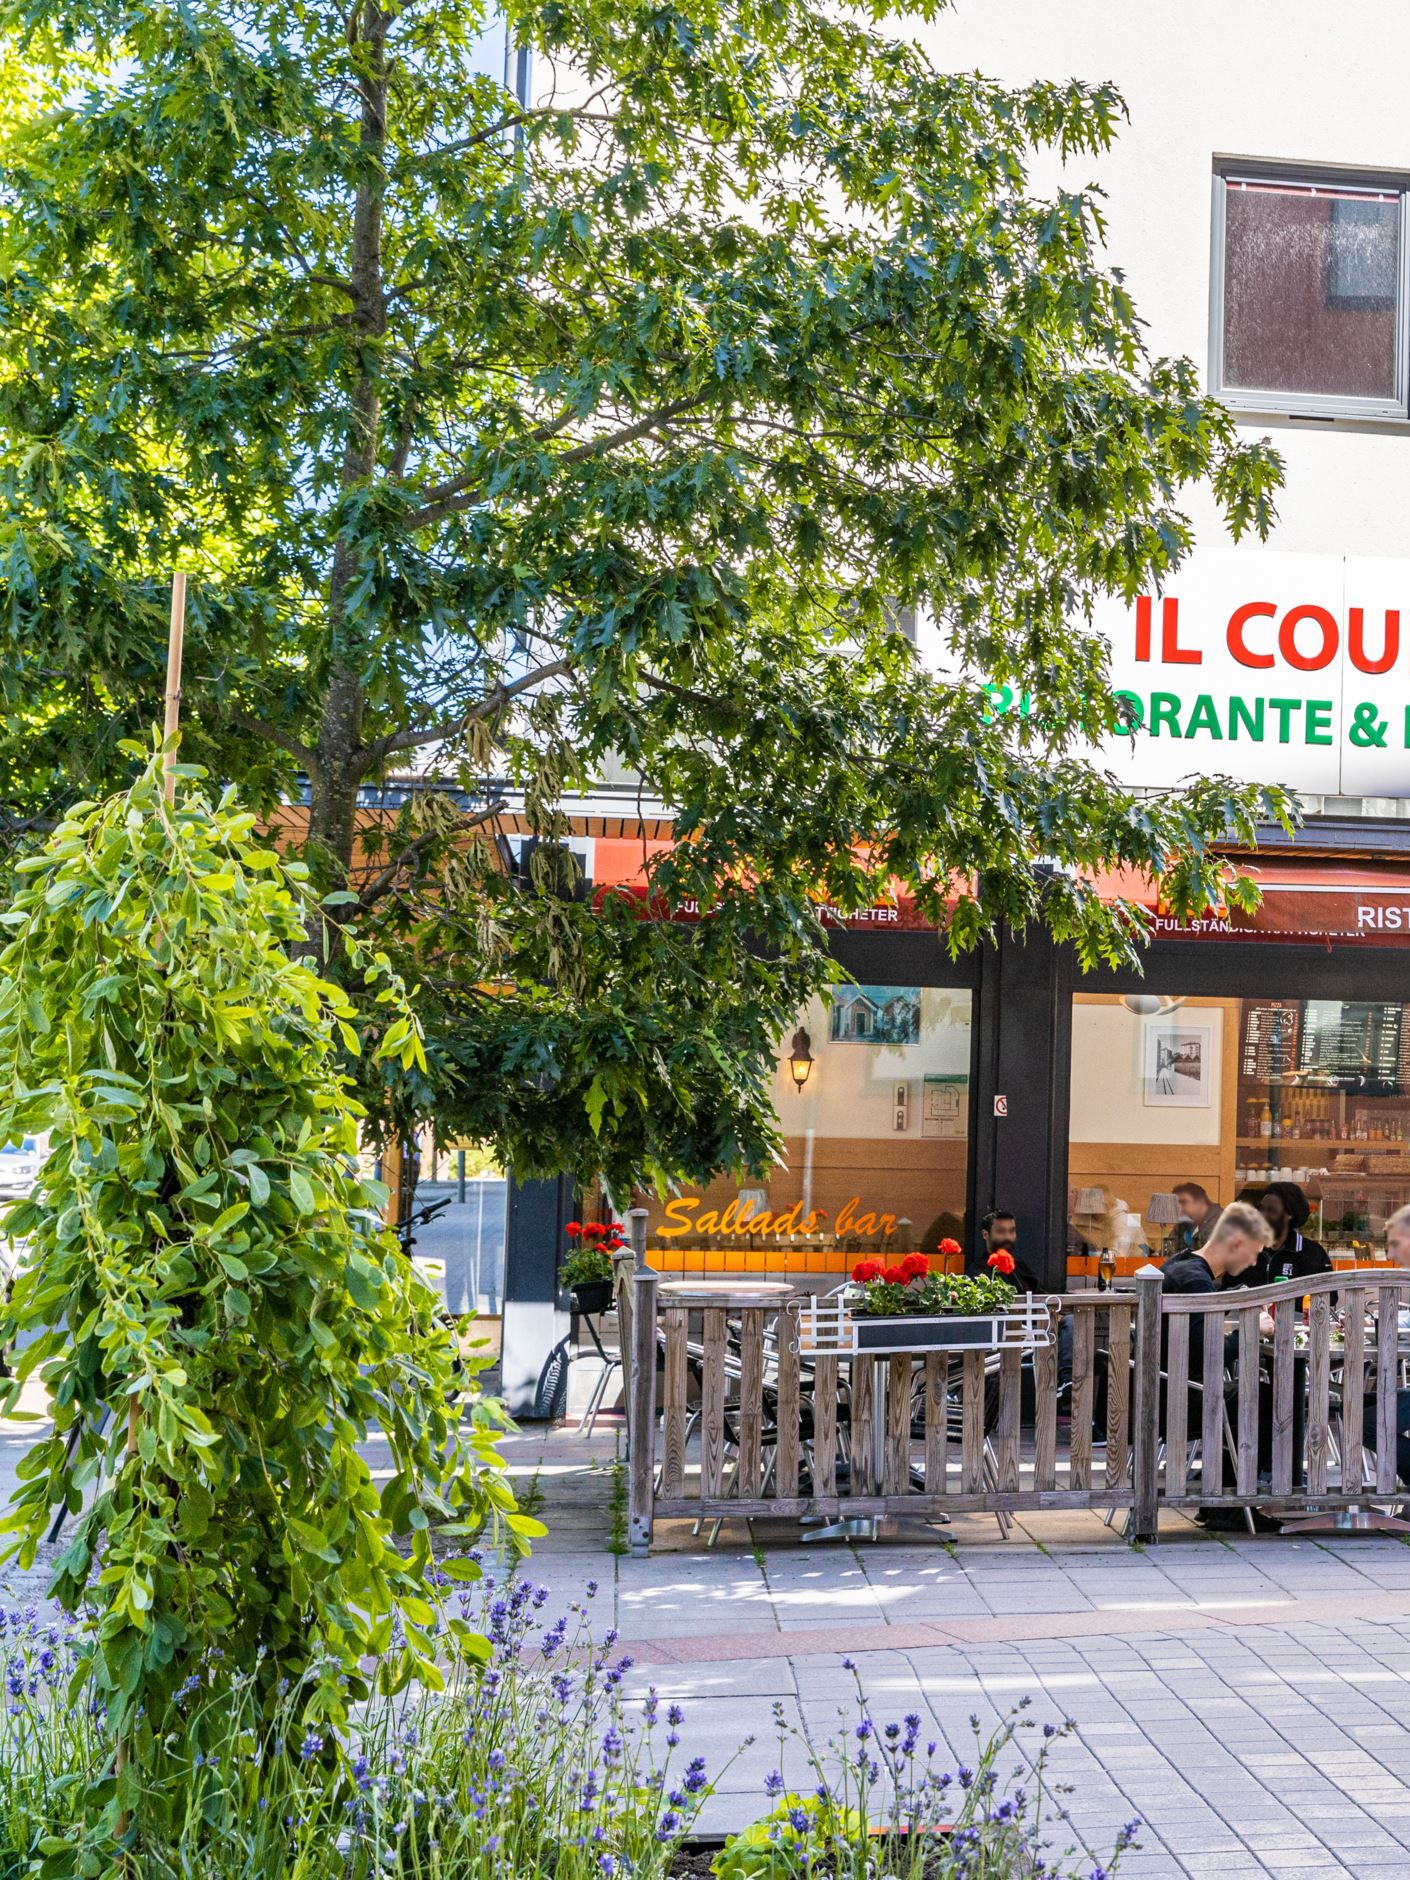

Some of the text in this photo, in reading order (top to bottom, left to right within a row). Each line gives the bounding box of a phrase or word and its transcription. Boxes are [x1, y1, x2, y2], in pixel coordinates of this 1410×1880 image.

[1135, 596, 1202, 665] IL
[980, 683, 1333, 746] RIORANTE
[1349, 701, 1388, 748] &
[656, 1196, 897, 1237] Sallads bar
